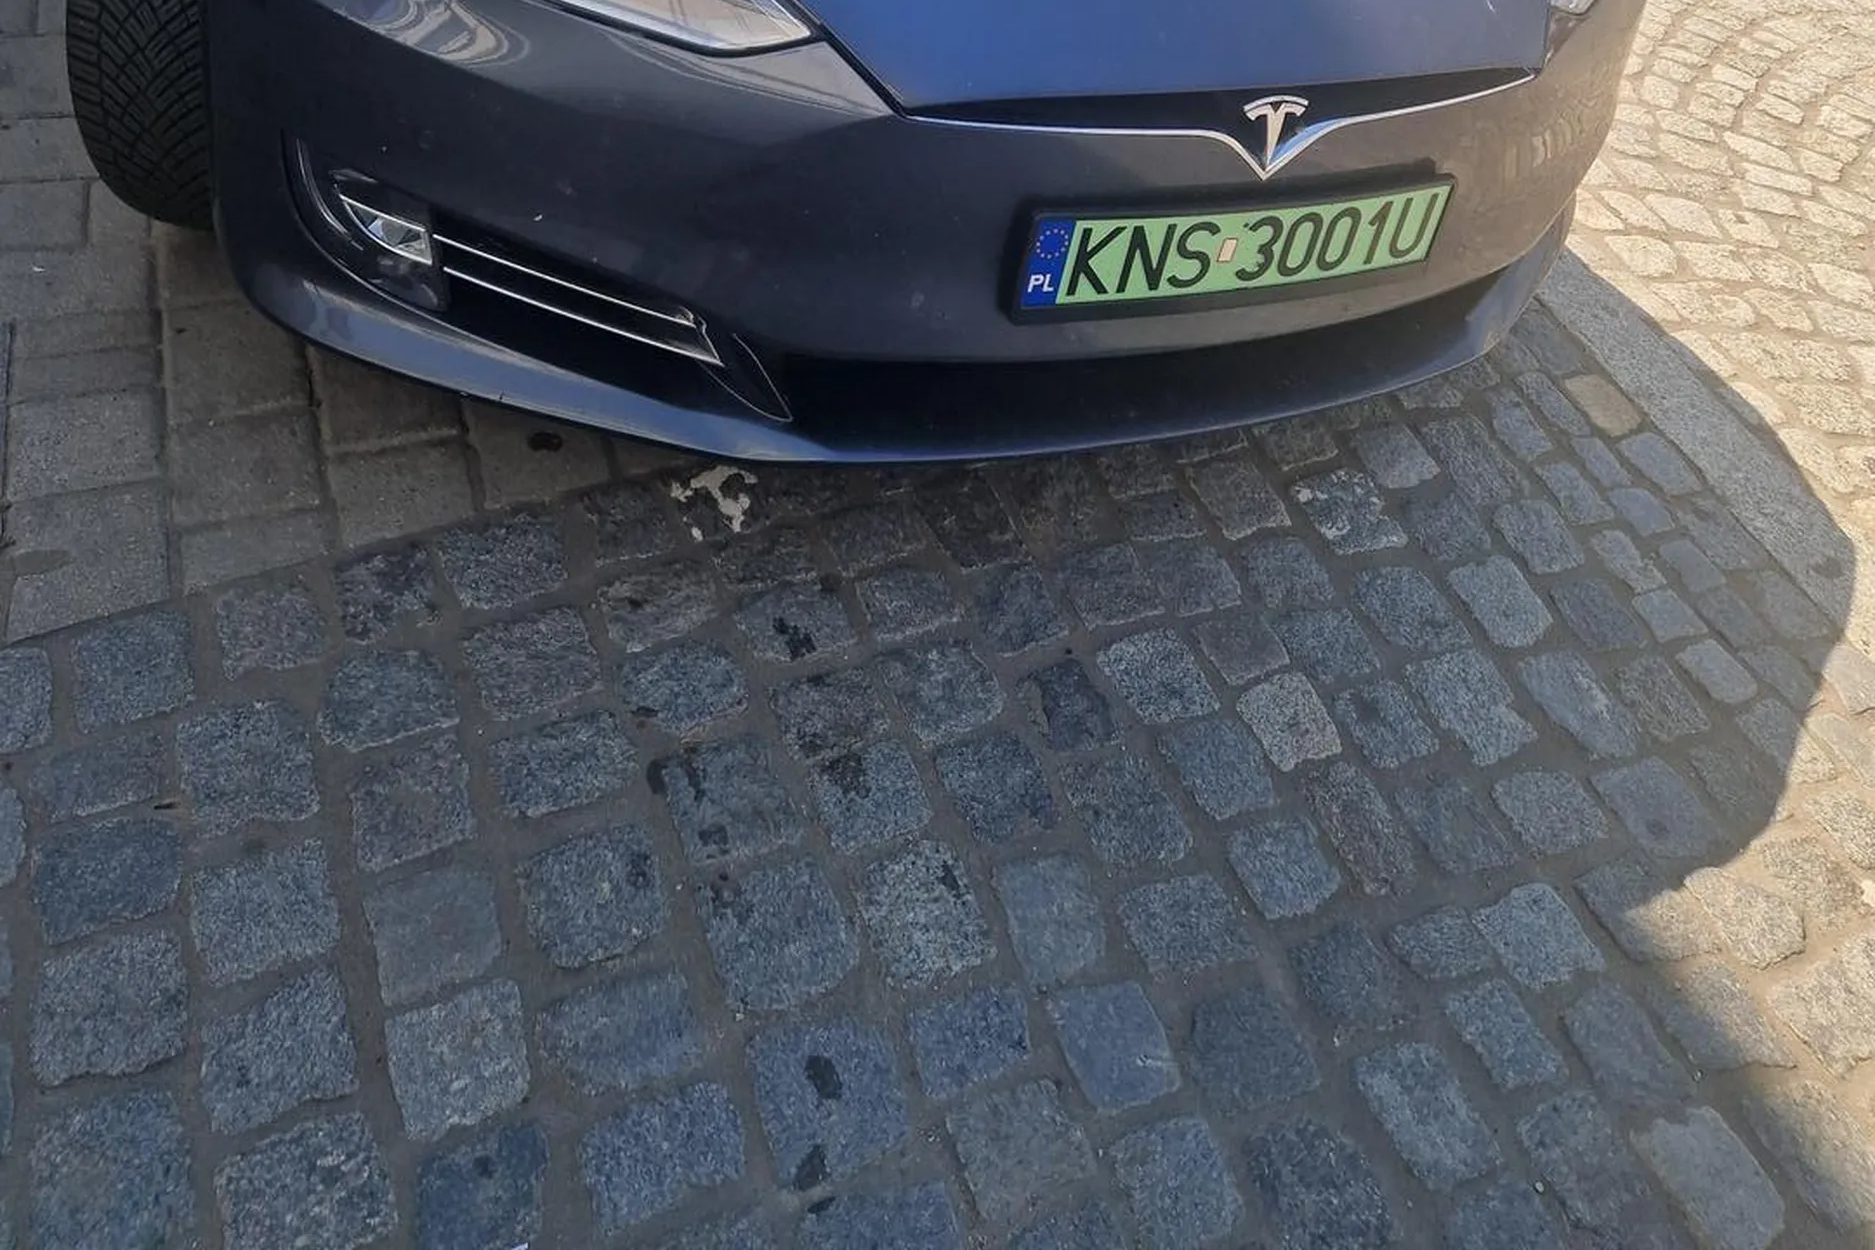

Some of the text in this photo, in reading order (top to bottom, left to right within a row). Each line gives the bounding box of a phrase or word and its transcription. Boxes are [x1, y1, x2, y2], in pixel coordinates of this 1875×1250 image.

[1065, 192, 1439, 296] KNS 3001U
[1027, 273, 1055, 293] PL
